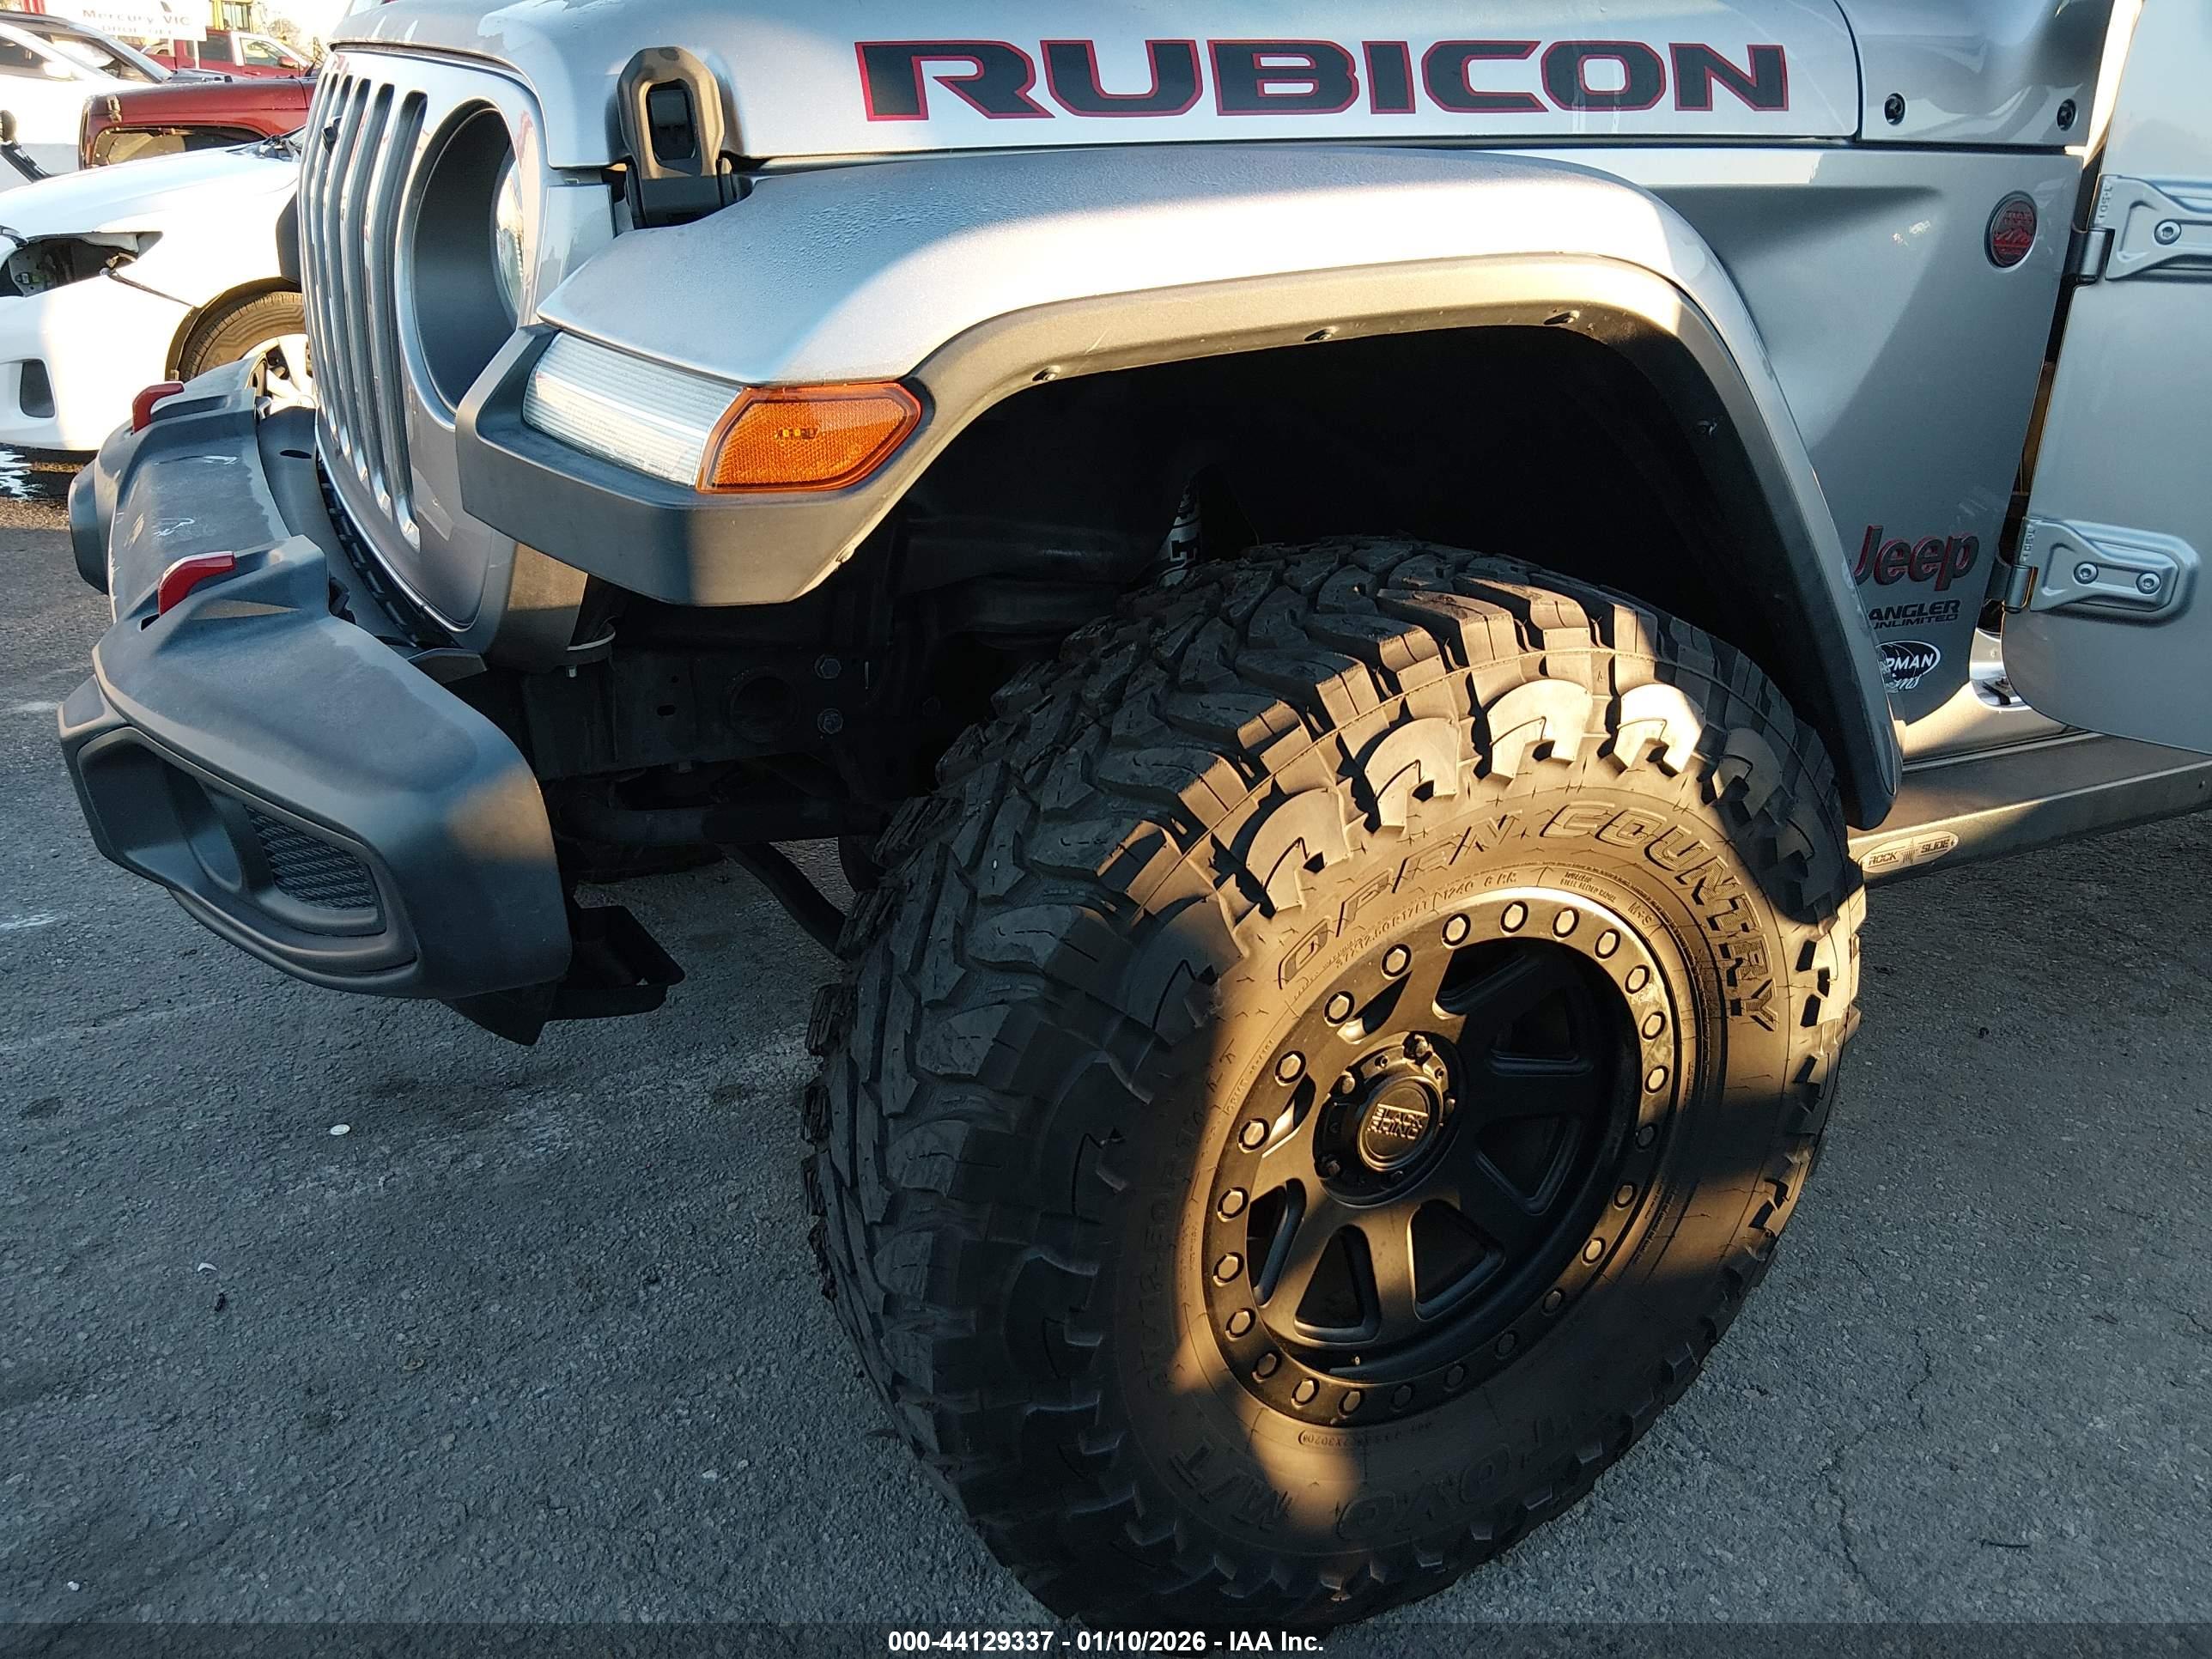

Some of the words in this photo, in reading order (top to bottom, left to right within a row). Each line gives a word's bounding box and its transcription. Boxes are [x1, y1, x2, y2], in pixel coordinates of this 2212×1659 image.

[163, 15, 191, 27] VIC
[857, 41, 1789, 120] RUBICON
[1854, 524, 1979, 592] Jeep
[1278, 809, 1523, 990] OPEN
[1539, 800, 1781, 1032] COUNTRY
